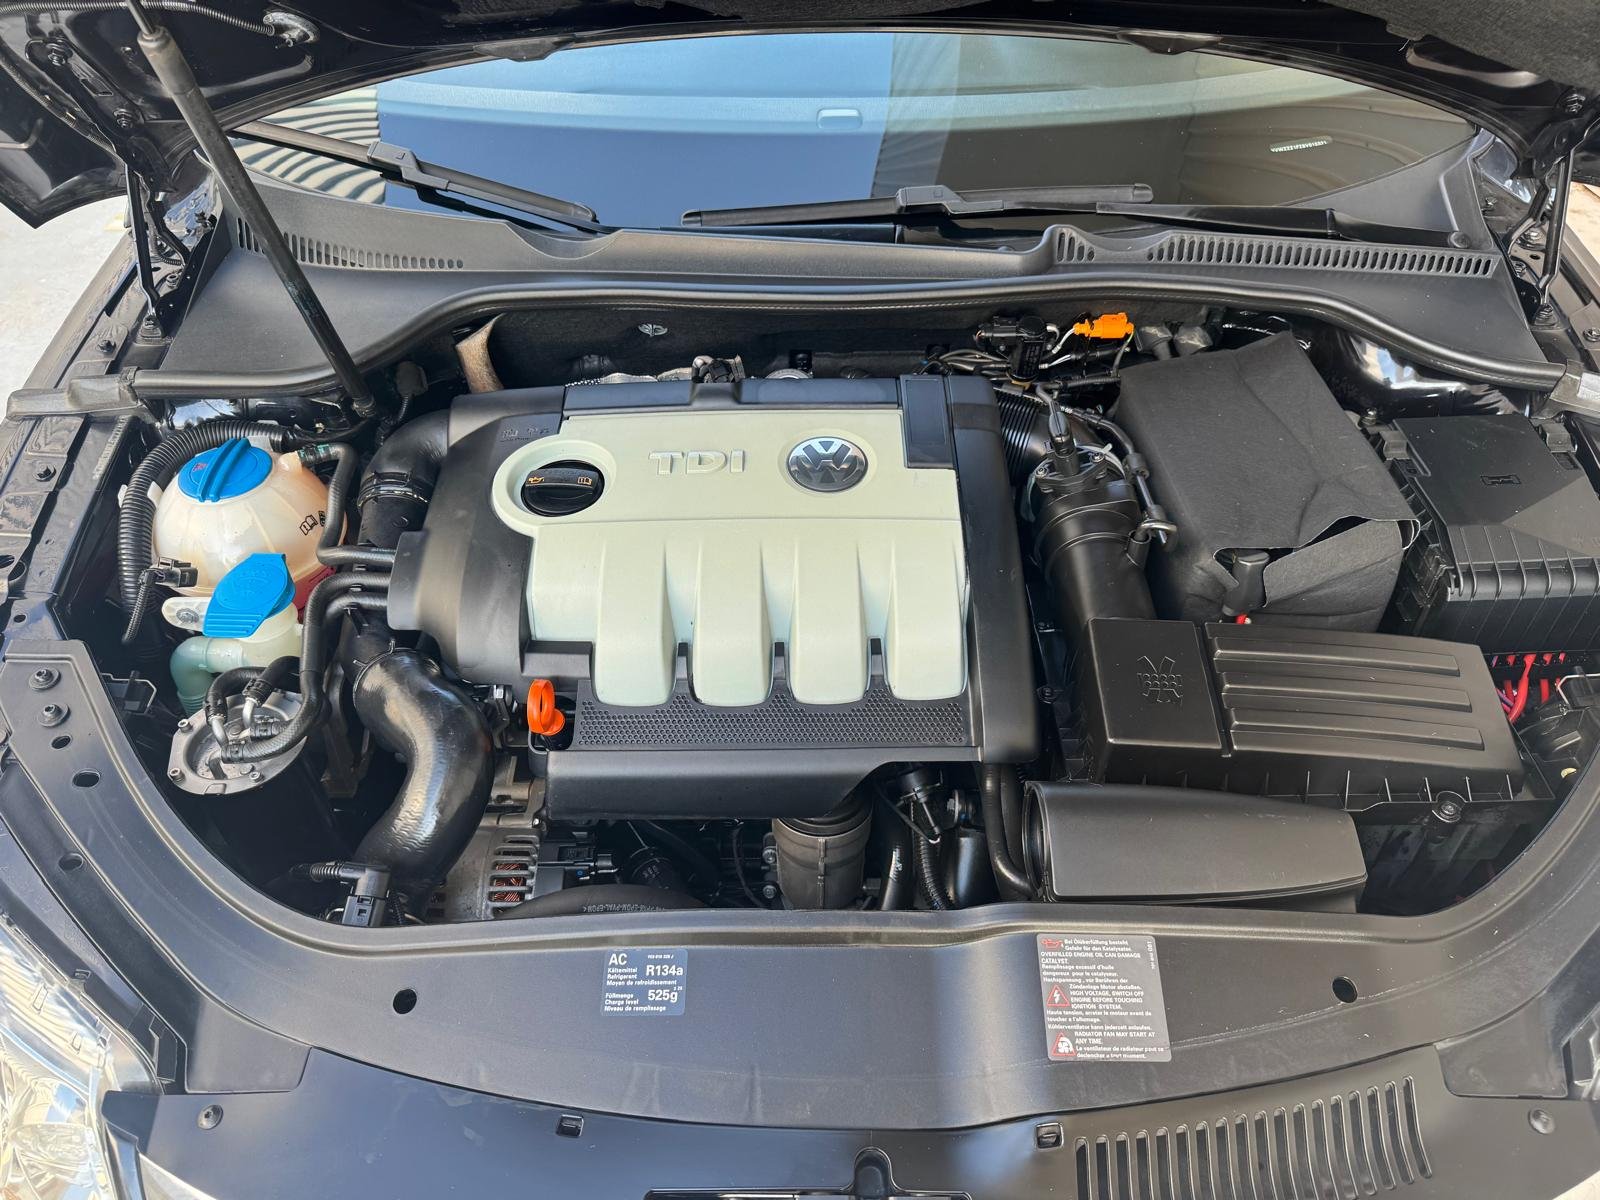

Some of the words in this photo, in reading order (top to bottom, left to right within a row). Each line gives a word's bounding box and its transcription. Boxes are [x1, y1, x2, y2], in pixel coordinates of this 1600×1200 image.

[648, 449, 746, 476] TDI
[608, 953, 628, 965] AC
[646, 965, 683, 976] R134a
[648, 990, 678, 1003] 525g
